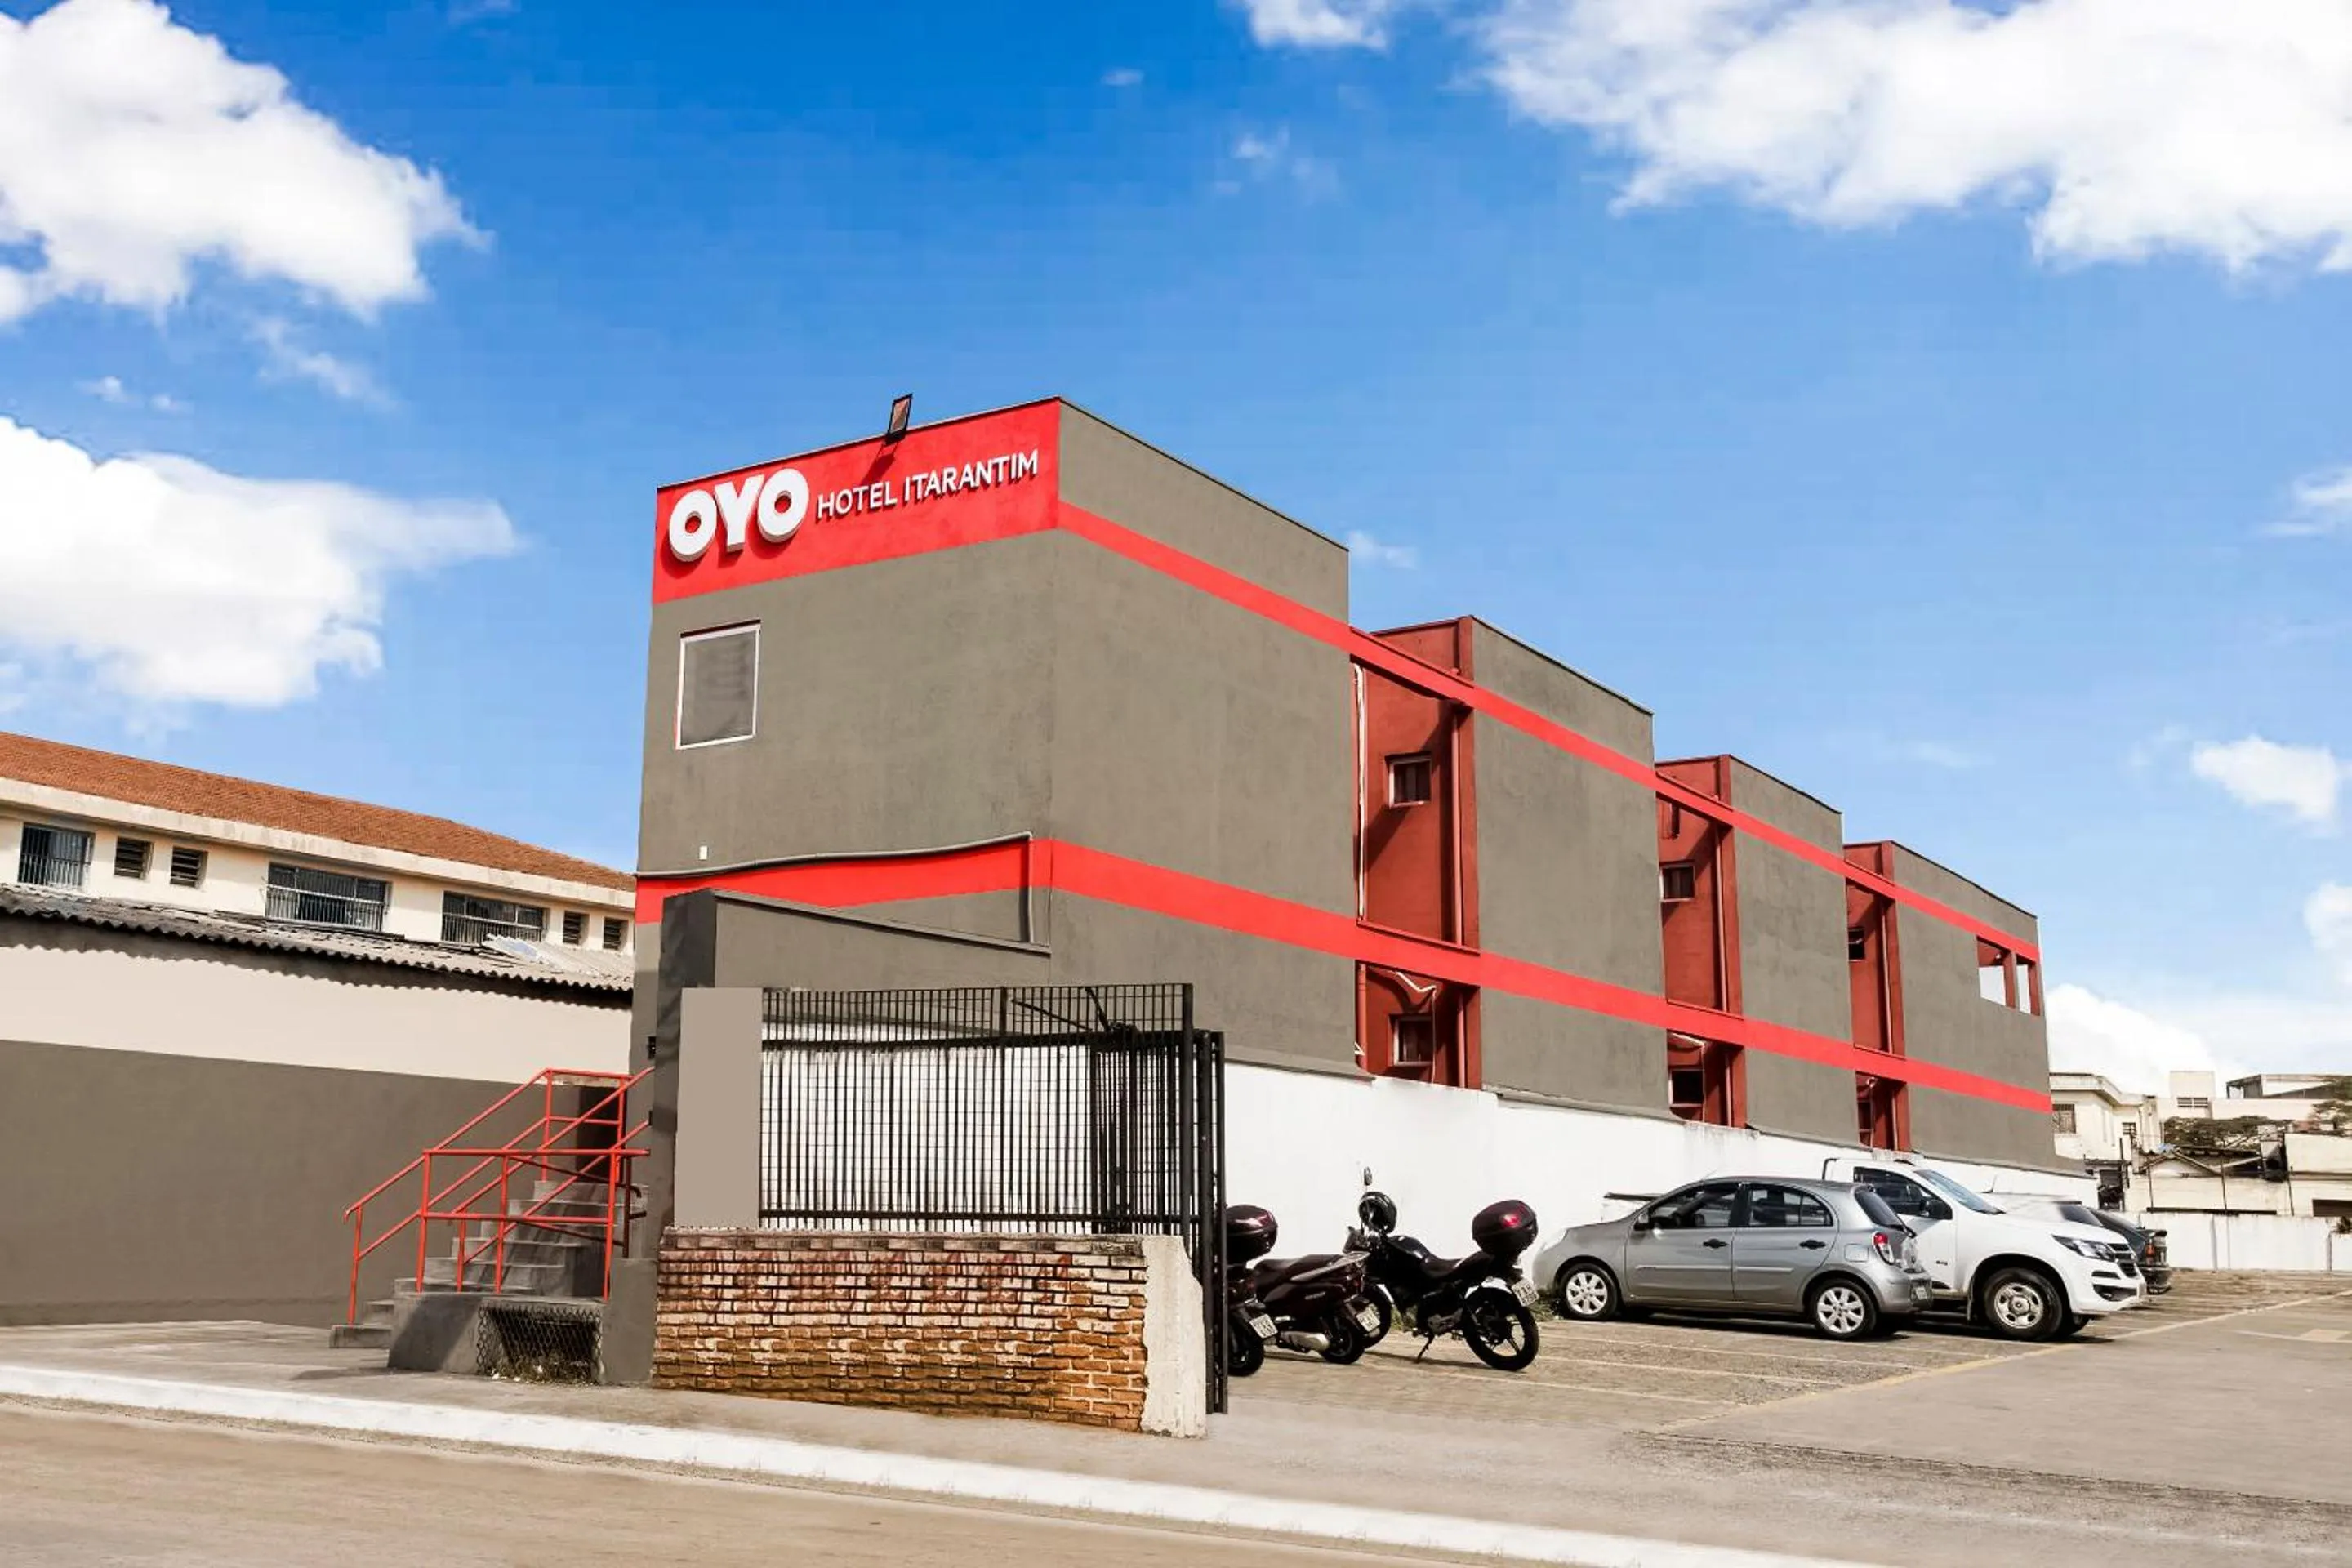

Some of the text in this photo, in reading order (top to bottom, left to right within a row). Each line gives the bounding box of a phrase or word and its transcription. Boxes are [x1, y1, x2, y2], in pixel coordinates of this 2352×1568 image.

[669, 448, 1039, 559] OYO HOTEL ITARANTIM
